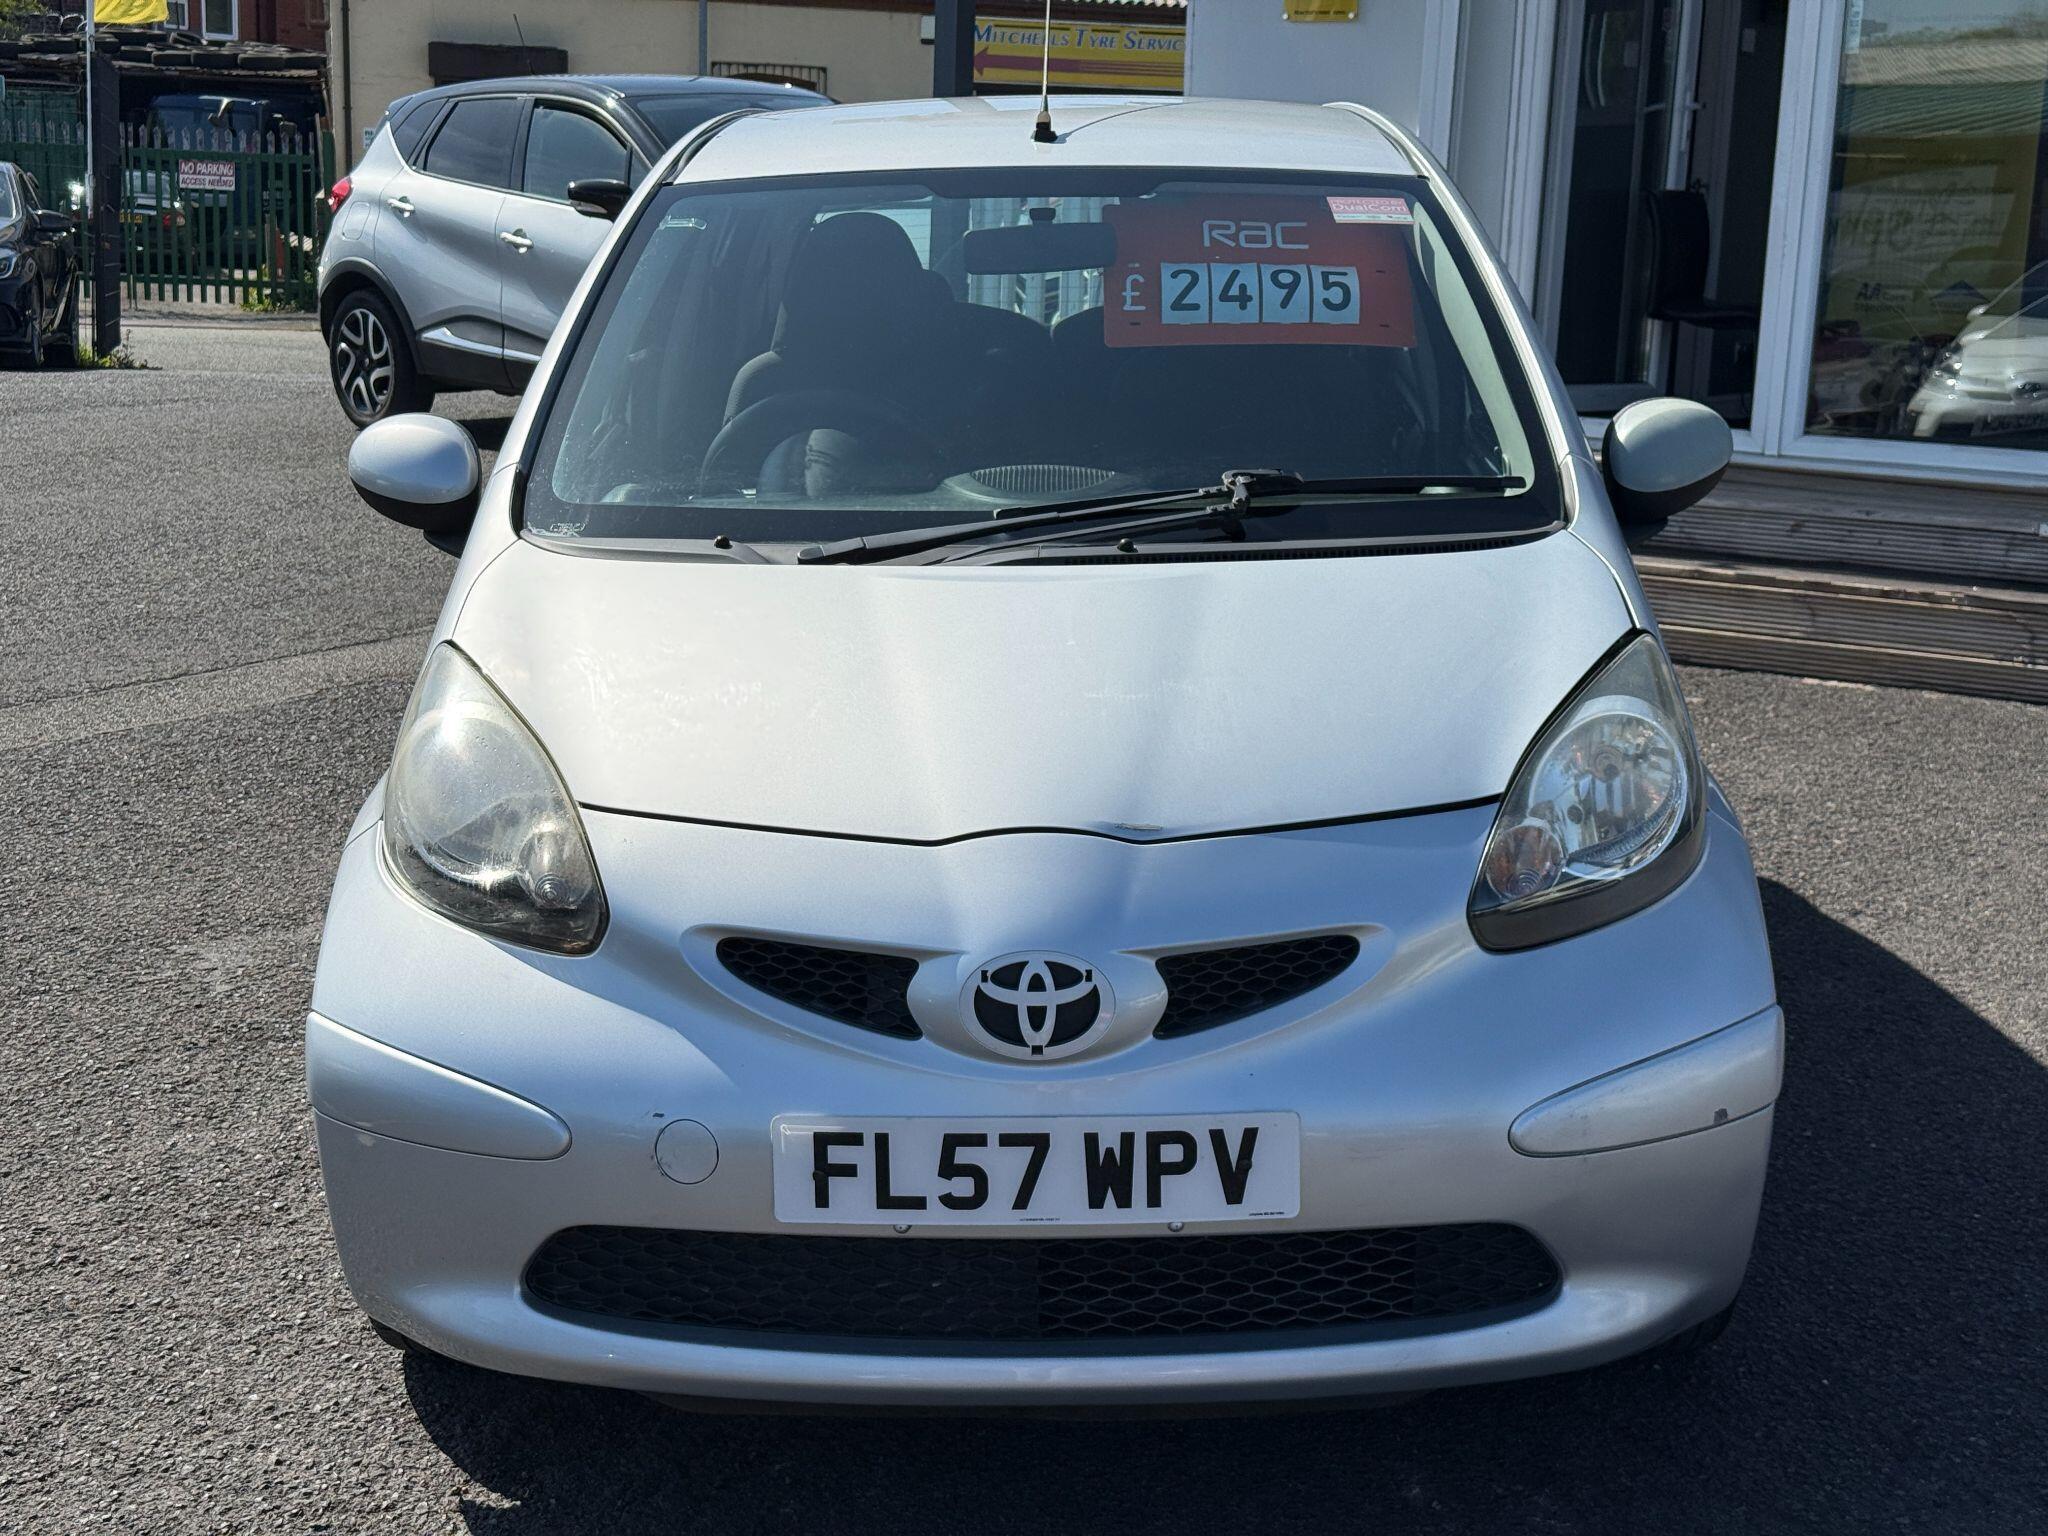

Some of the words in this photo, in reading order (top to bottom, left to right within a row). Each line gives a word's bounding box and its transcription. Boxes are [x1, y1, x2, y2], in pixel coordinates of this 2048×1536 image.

[180, 161, 194, 174] NO
[196, 162, 233, 176] PARKING
[181, 177, 207, 186] ACCESS
[812, 1131, 1052, 1211] FL57
[1083, 1126, 1260, 1209] WPV
